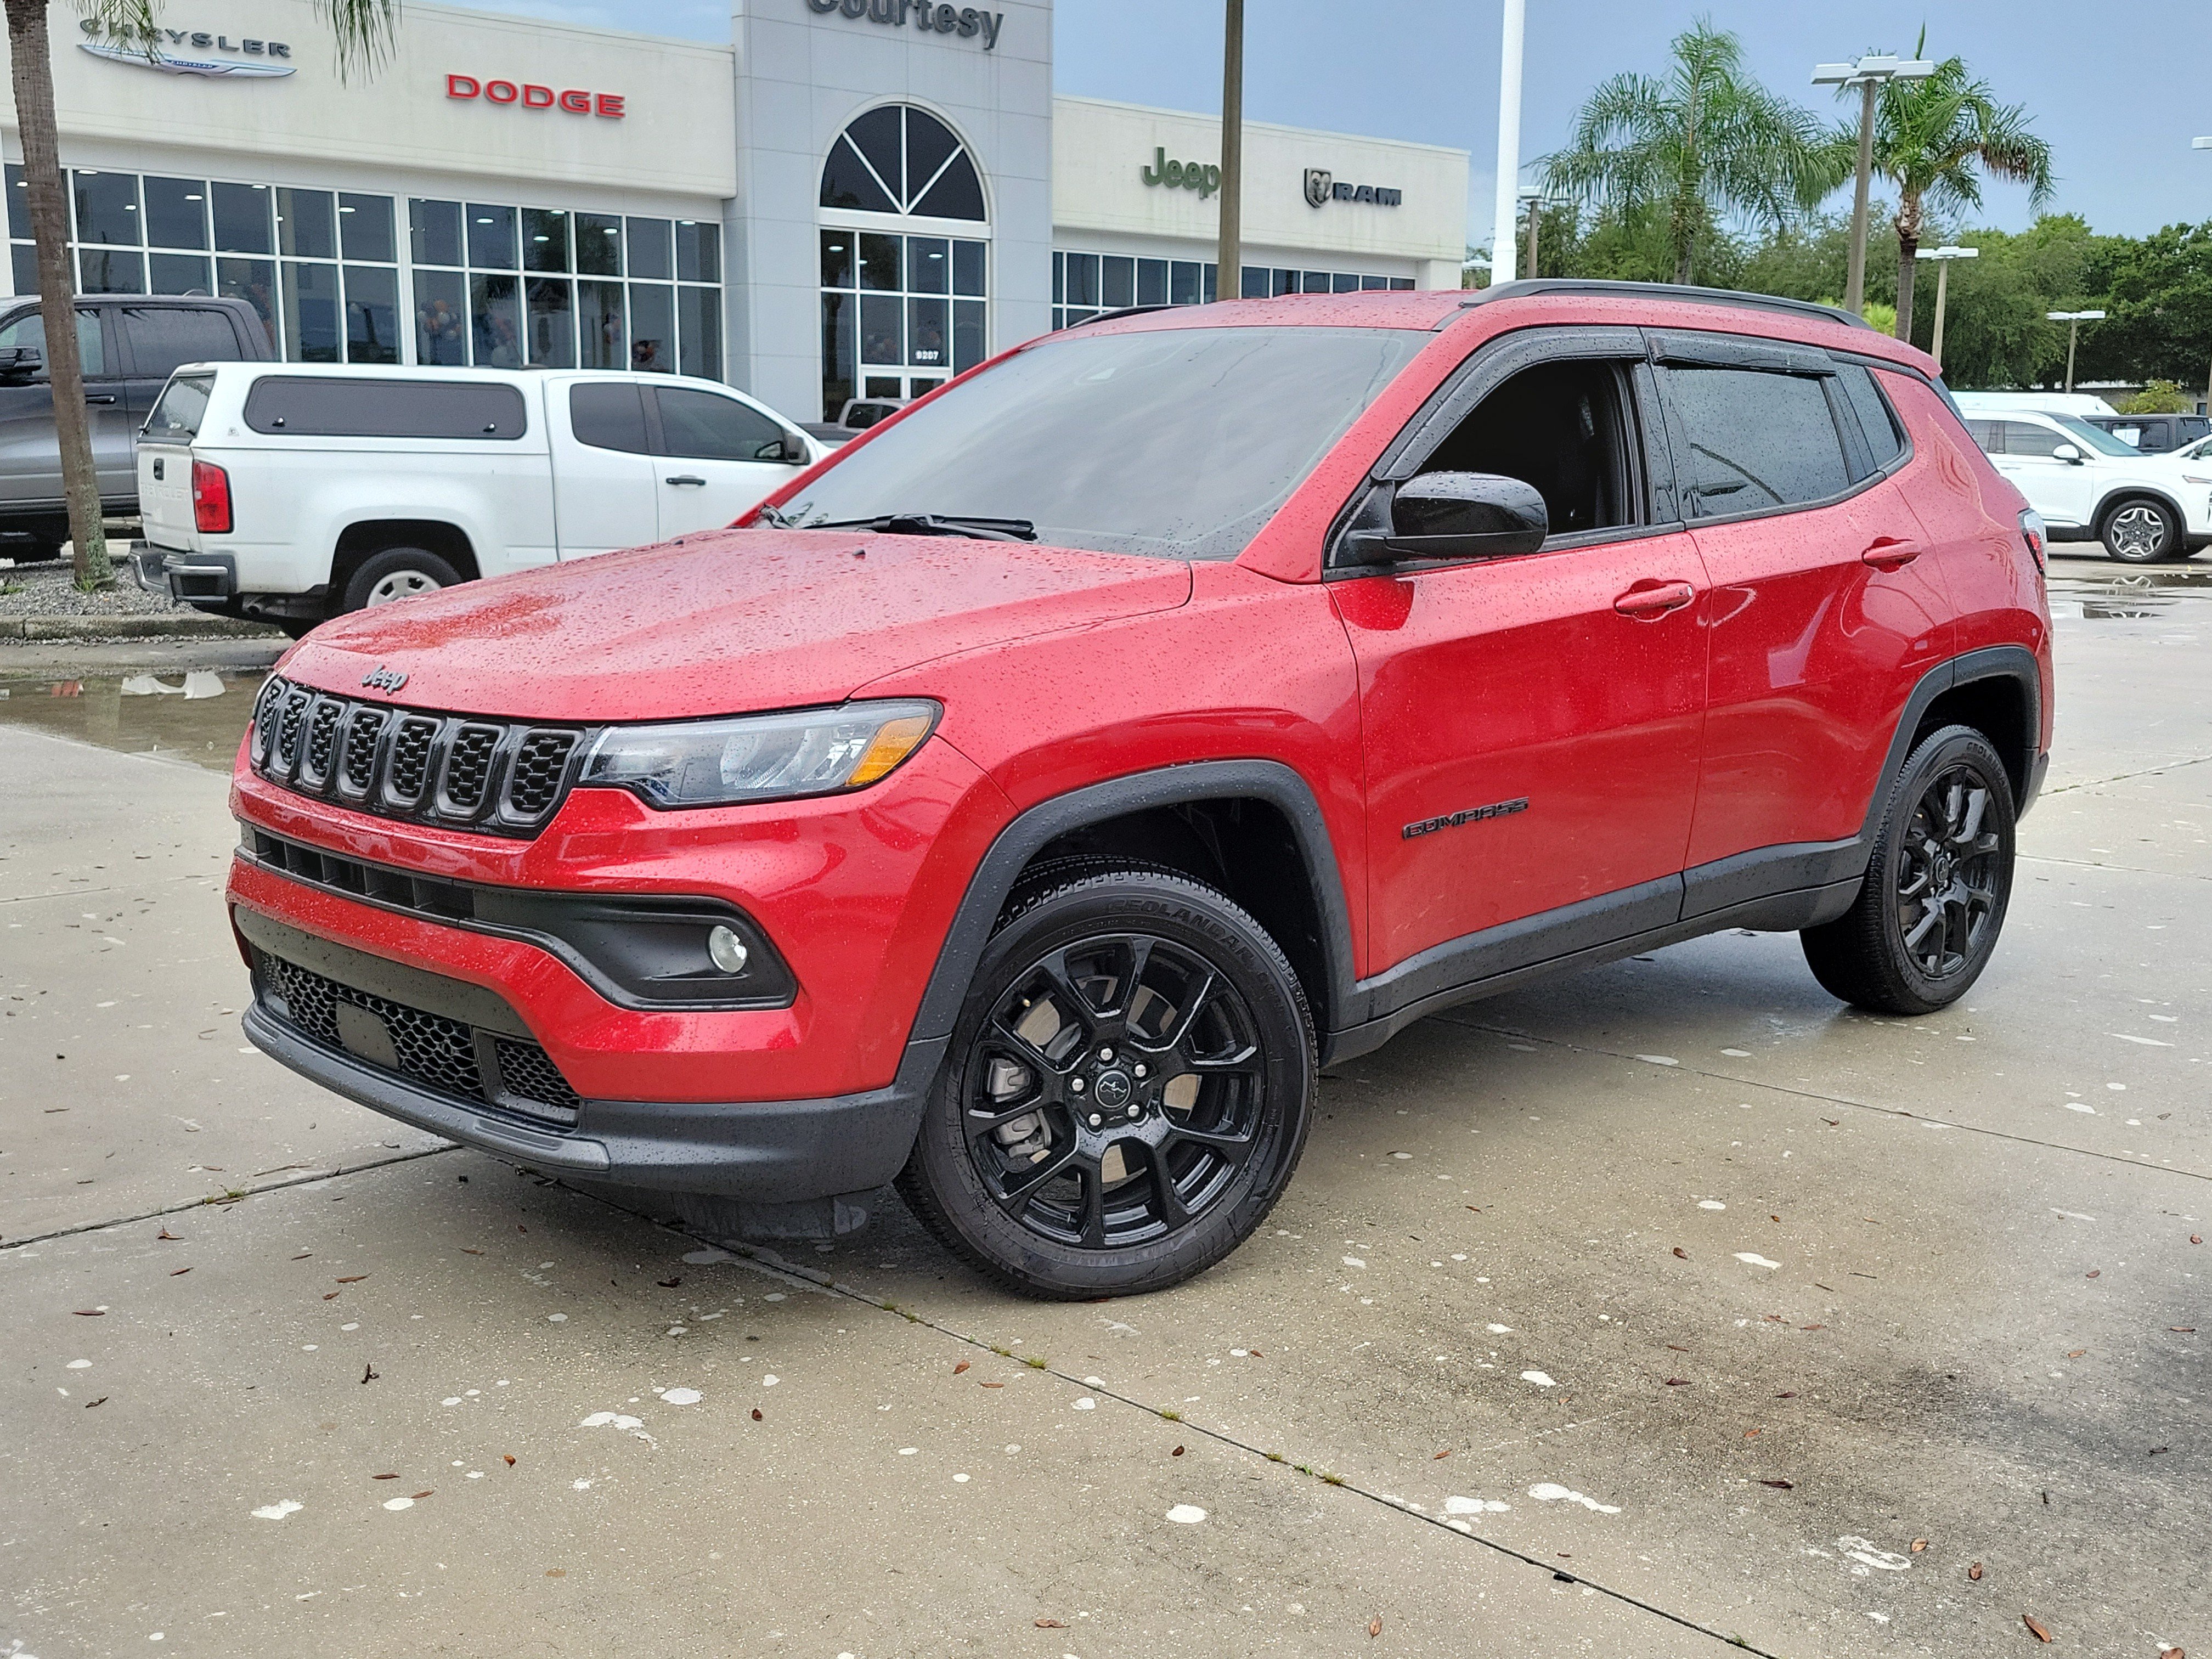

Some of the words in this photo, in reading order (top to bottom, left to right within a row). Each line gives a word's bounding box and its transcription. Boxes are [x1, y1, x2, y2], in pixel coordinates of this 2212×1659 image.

[445, 74, 625, 119] DODGE
[1141, 146, 1222, 200] Jeep
[1333, 182, 1402, 206] RAM
[361, 663, 410, 696] Jeep
[1402, 797, 1530, 839] COMPASS
[1107, 899, 1255, 961] GEOLANDAR
